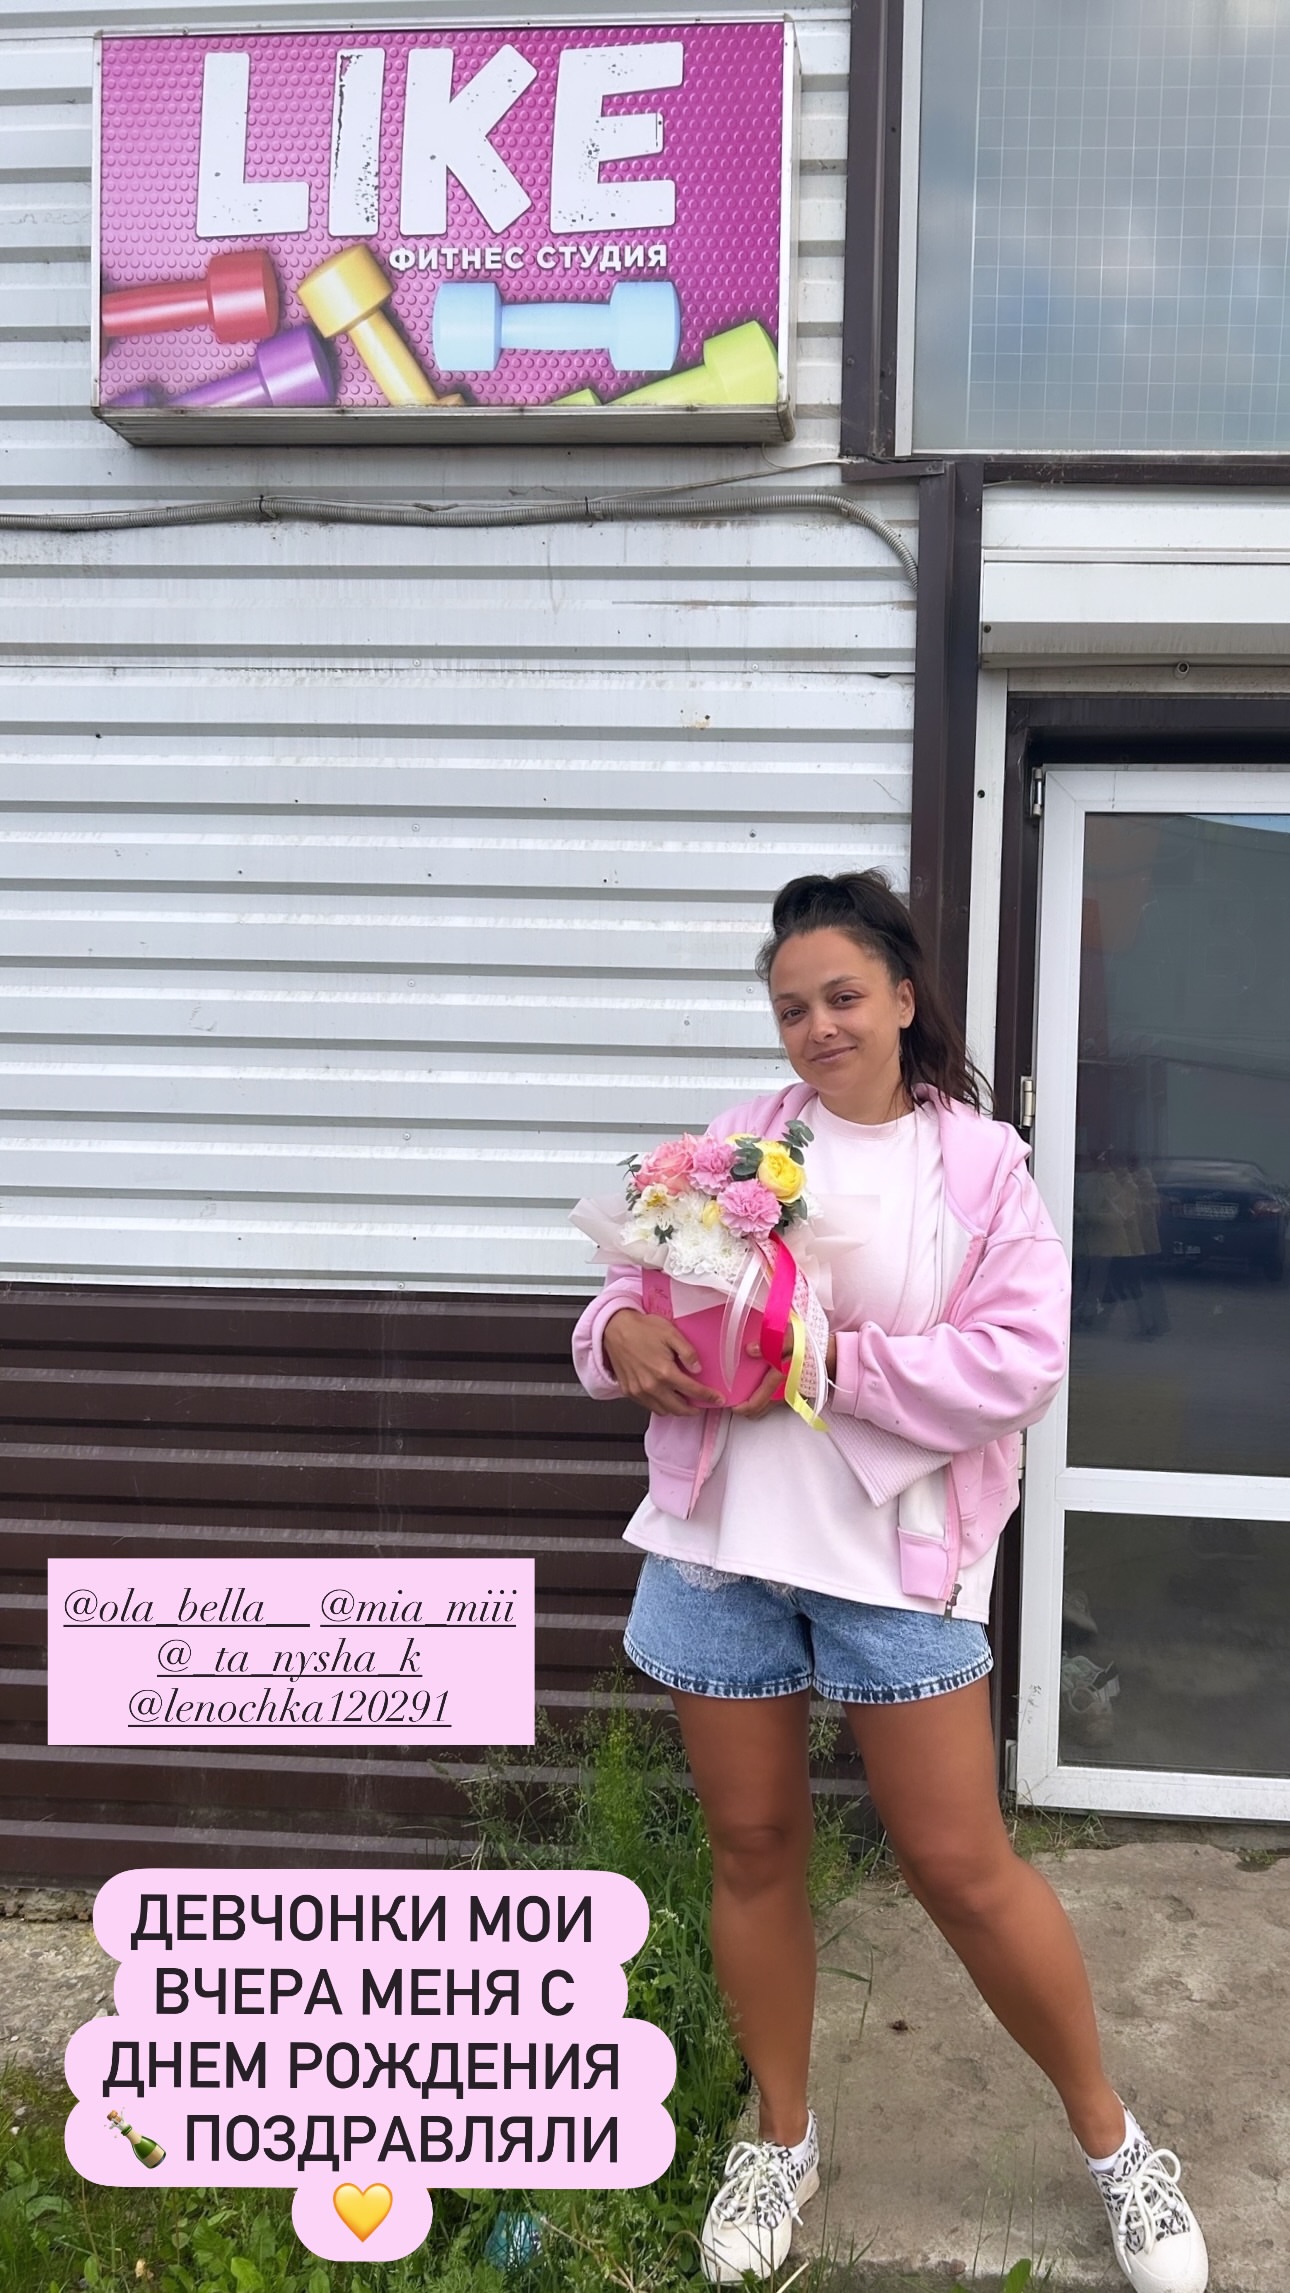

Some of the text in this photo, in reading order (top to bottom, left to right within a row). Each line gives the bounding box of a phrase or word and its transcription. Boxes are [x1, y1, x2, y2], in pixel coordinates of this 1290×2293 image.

[196, 43, 685, 238] LIKE
[388, 244, 667, 271] ФИТНЕС СТУДИЯ
